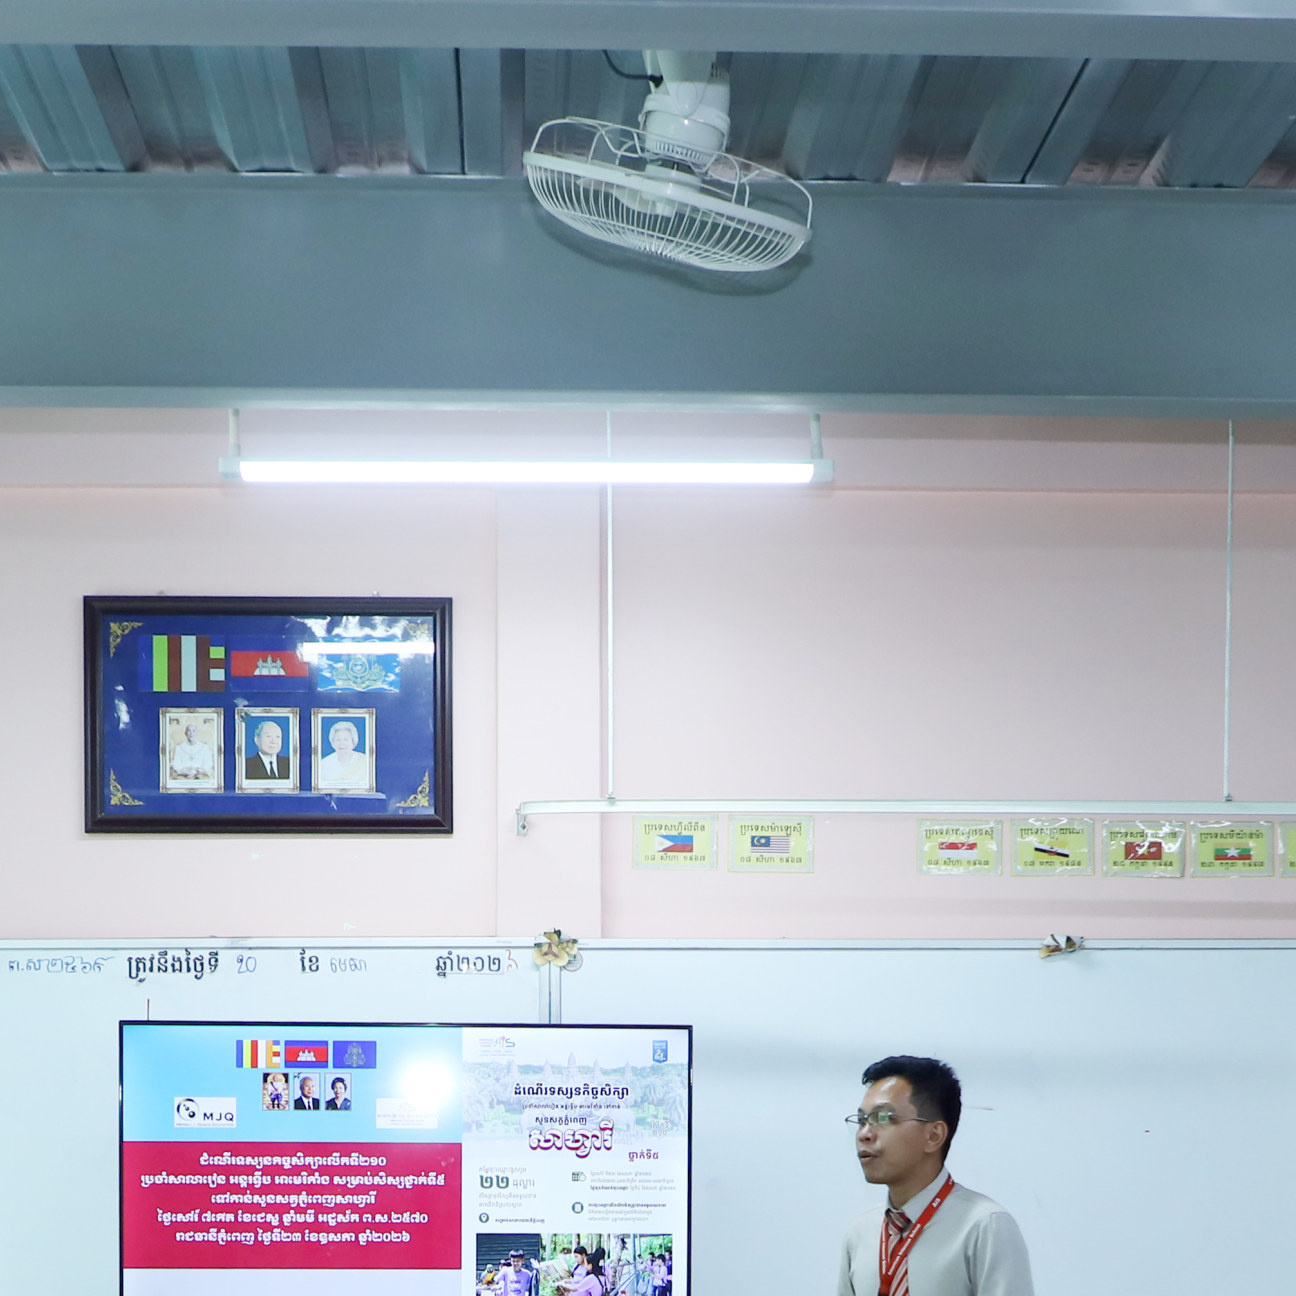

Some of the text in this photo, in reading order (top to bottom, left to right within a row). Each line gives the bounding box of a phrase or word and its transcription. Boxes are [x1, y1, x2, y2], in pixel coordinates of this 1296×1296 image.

[299, 949, 320, 973] ខែ
[514, 1083, 629, 1100] ដំណើរទស្សនកិច្ចសិក្សា
[202, 1112, 235, 1122] MJQ
[528, 1119, 615, 1159] សាហ្វារី
[628, 1149, 660, 1162] ថ្នាក់ទី៥
